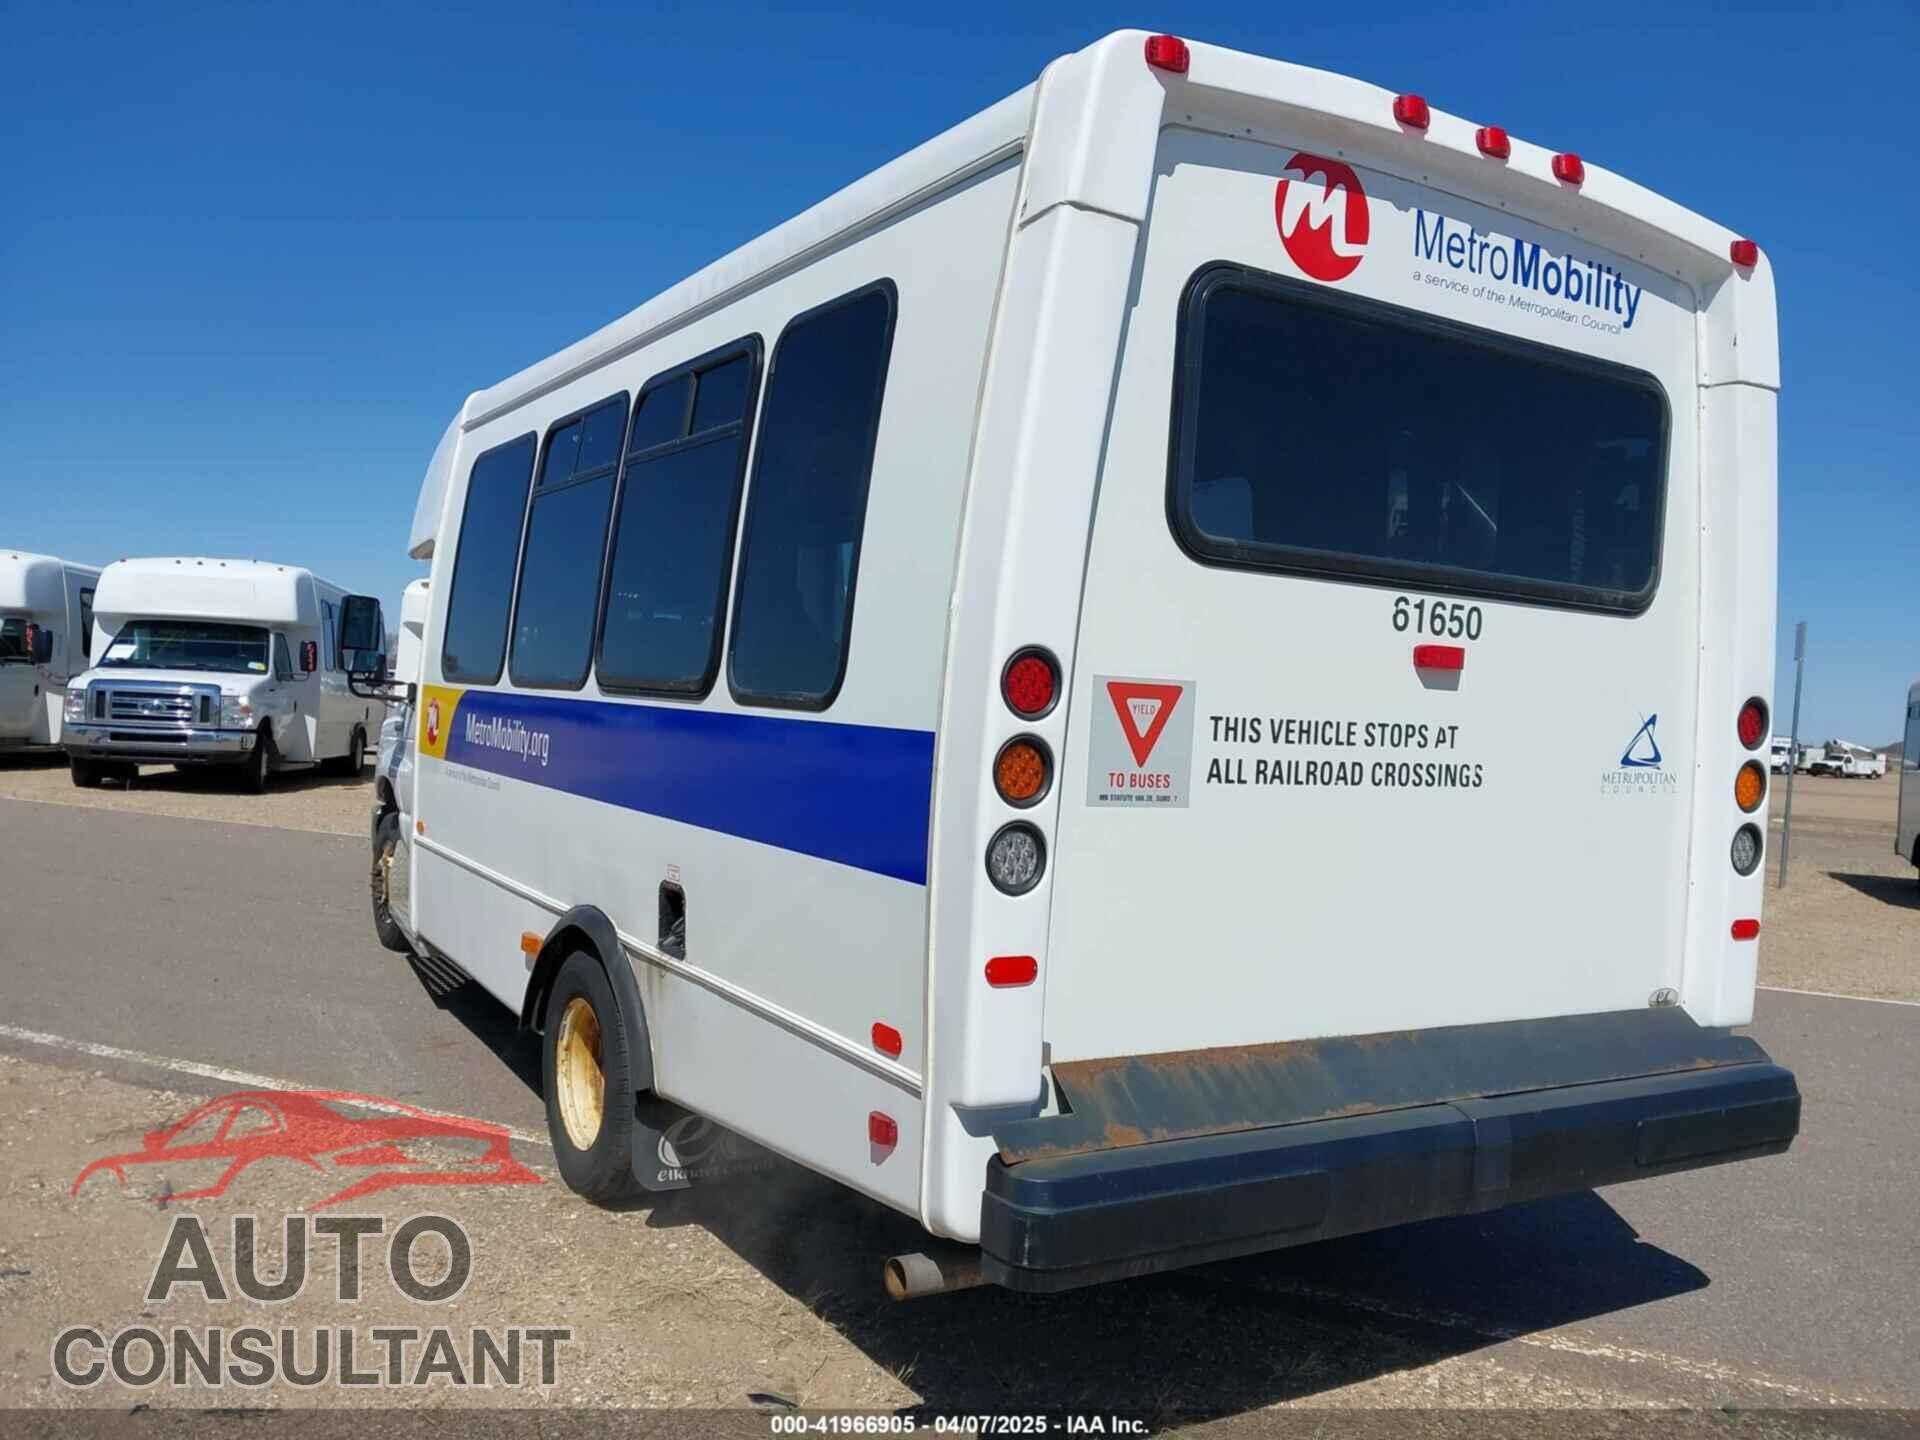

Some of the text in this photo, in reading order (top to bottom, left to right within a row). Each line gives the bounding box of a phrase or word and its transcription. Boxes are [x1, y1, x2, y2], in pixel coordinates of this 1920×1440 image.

[1414, 208, 1641, 329] MetroMobility
[1412, 270, 1622, 335] a service of the Metropolitan Council
[1391, 595, 1483, 641] 61650
[1133, 703, 1156, 715] YIELD
[465, 712, 550, 767] MetroMobility.org
[1209, 715, 1459, 749] THIS VEHICLE STOPS AT
[1109, 772, 1171, 789] TO BUSES
[1206, 757, 1484, 788] ALL RAILROAD CROSSINGS
[1601, 771, 1677, 785] METROPOLITAN
